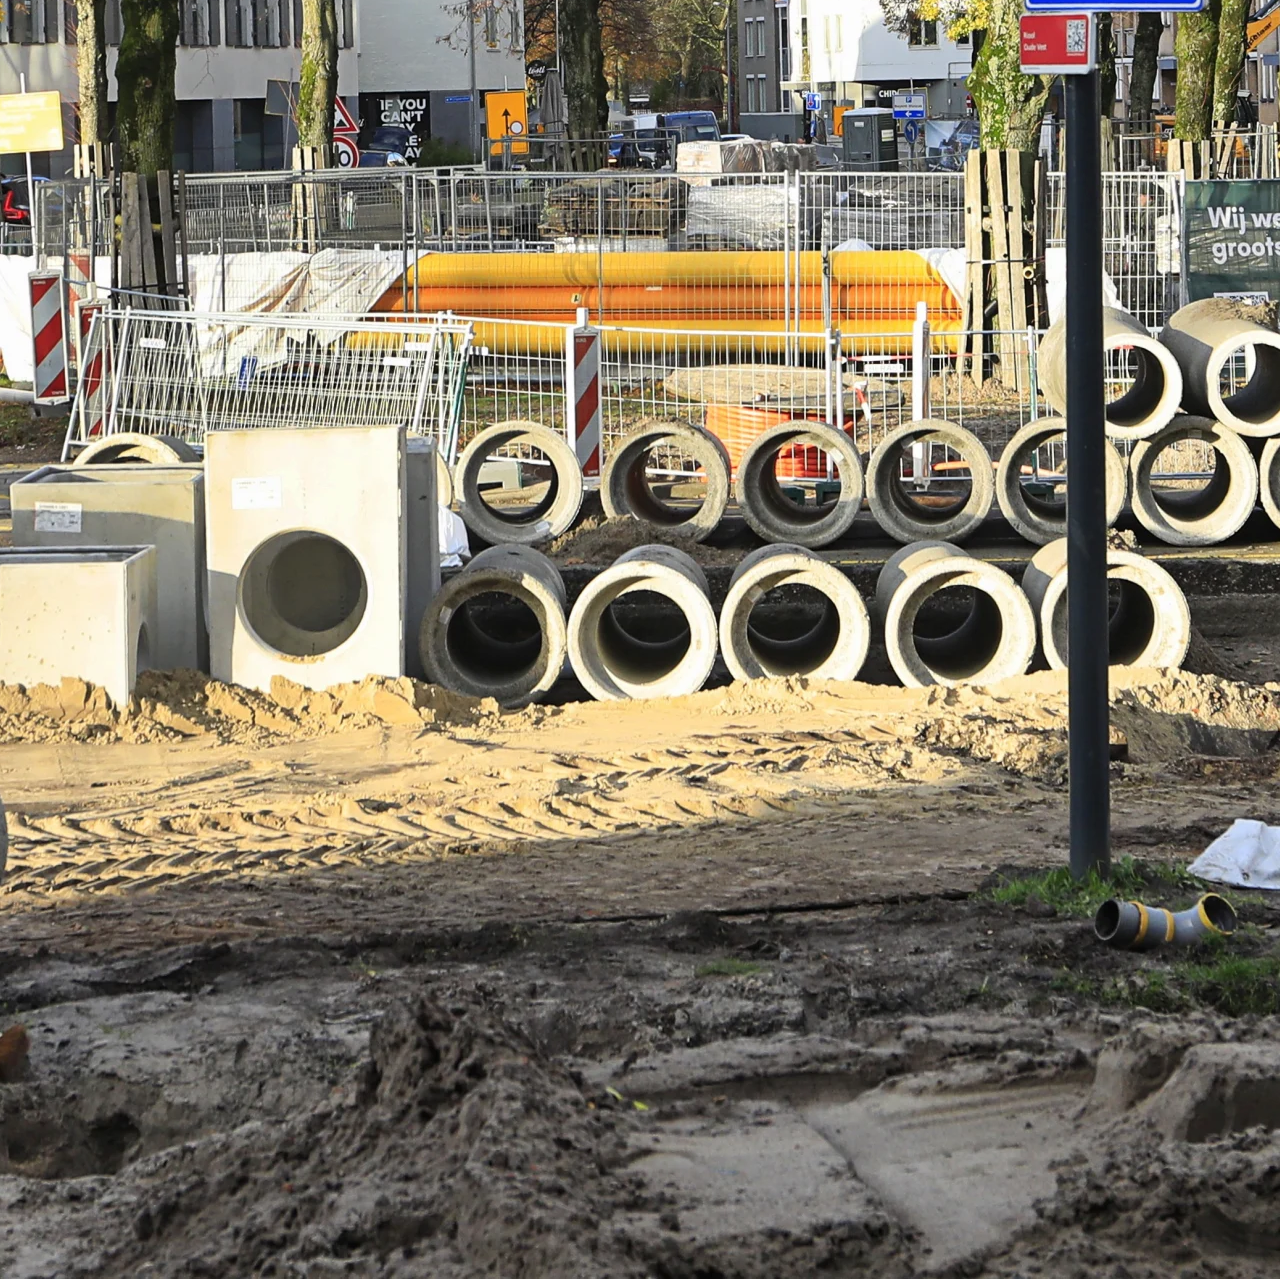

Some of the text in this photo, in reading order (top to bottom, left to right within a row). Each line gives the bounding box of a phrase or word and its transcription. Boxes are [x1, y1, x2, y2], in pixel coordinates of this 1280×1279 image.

[380, 99, 426, 111] IF YOU
[381, 111, 424, 122] CAN'T
[1208, 206, 1245, 235] Wij
